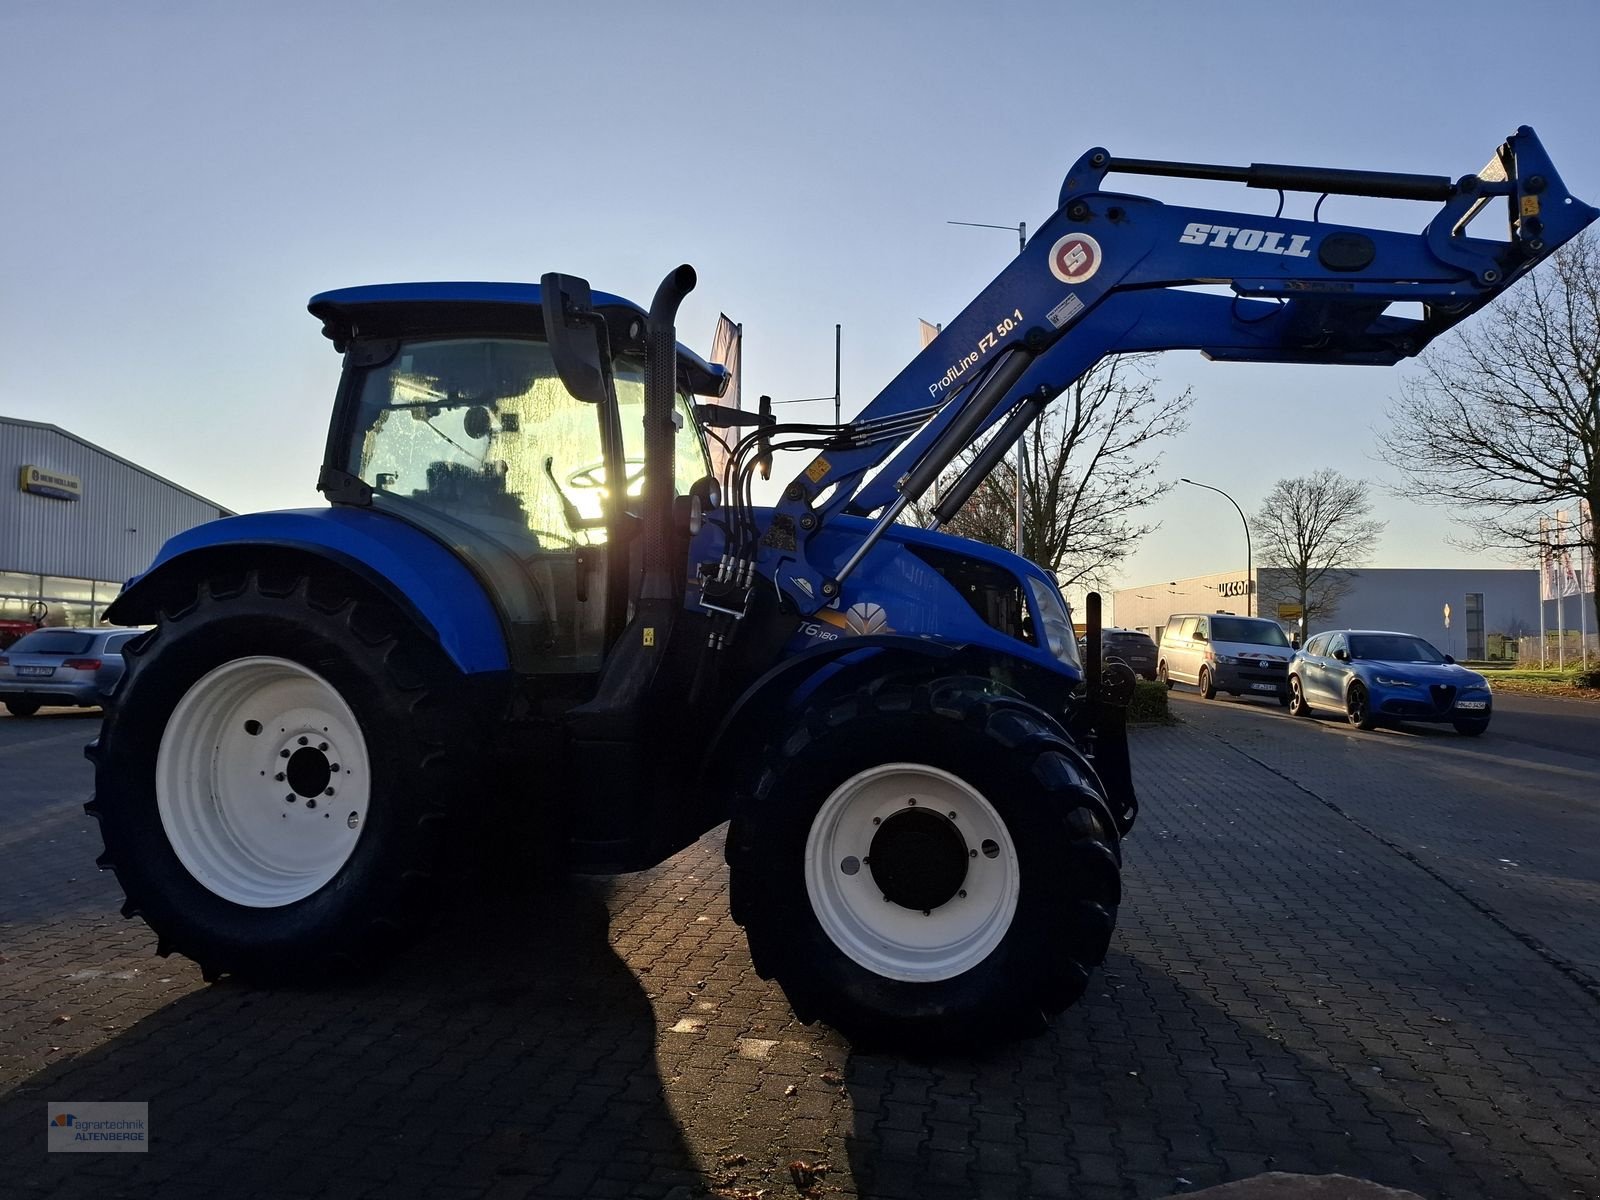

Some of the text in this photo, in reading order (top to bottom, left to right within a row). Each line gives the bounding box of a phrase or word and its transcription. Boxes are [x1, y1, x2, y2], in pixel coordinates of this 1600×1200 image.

[1179, 223, 1311, 258] STOLL
[928, 351, 979, 398] ProfiLine
[978, 332, 999, 354] FZ
[996, 308, 1024, 337] 50.1
[40, 475, 78, 488] NEW HOLLAND
